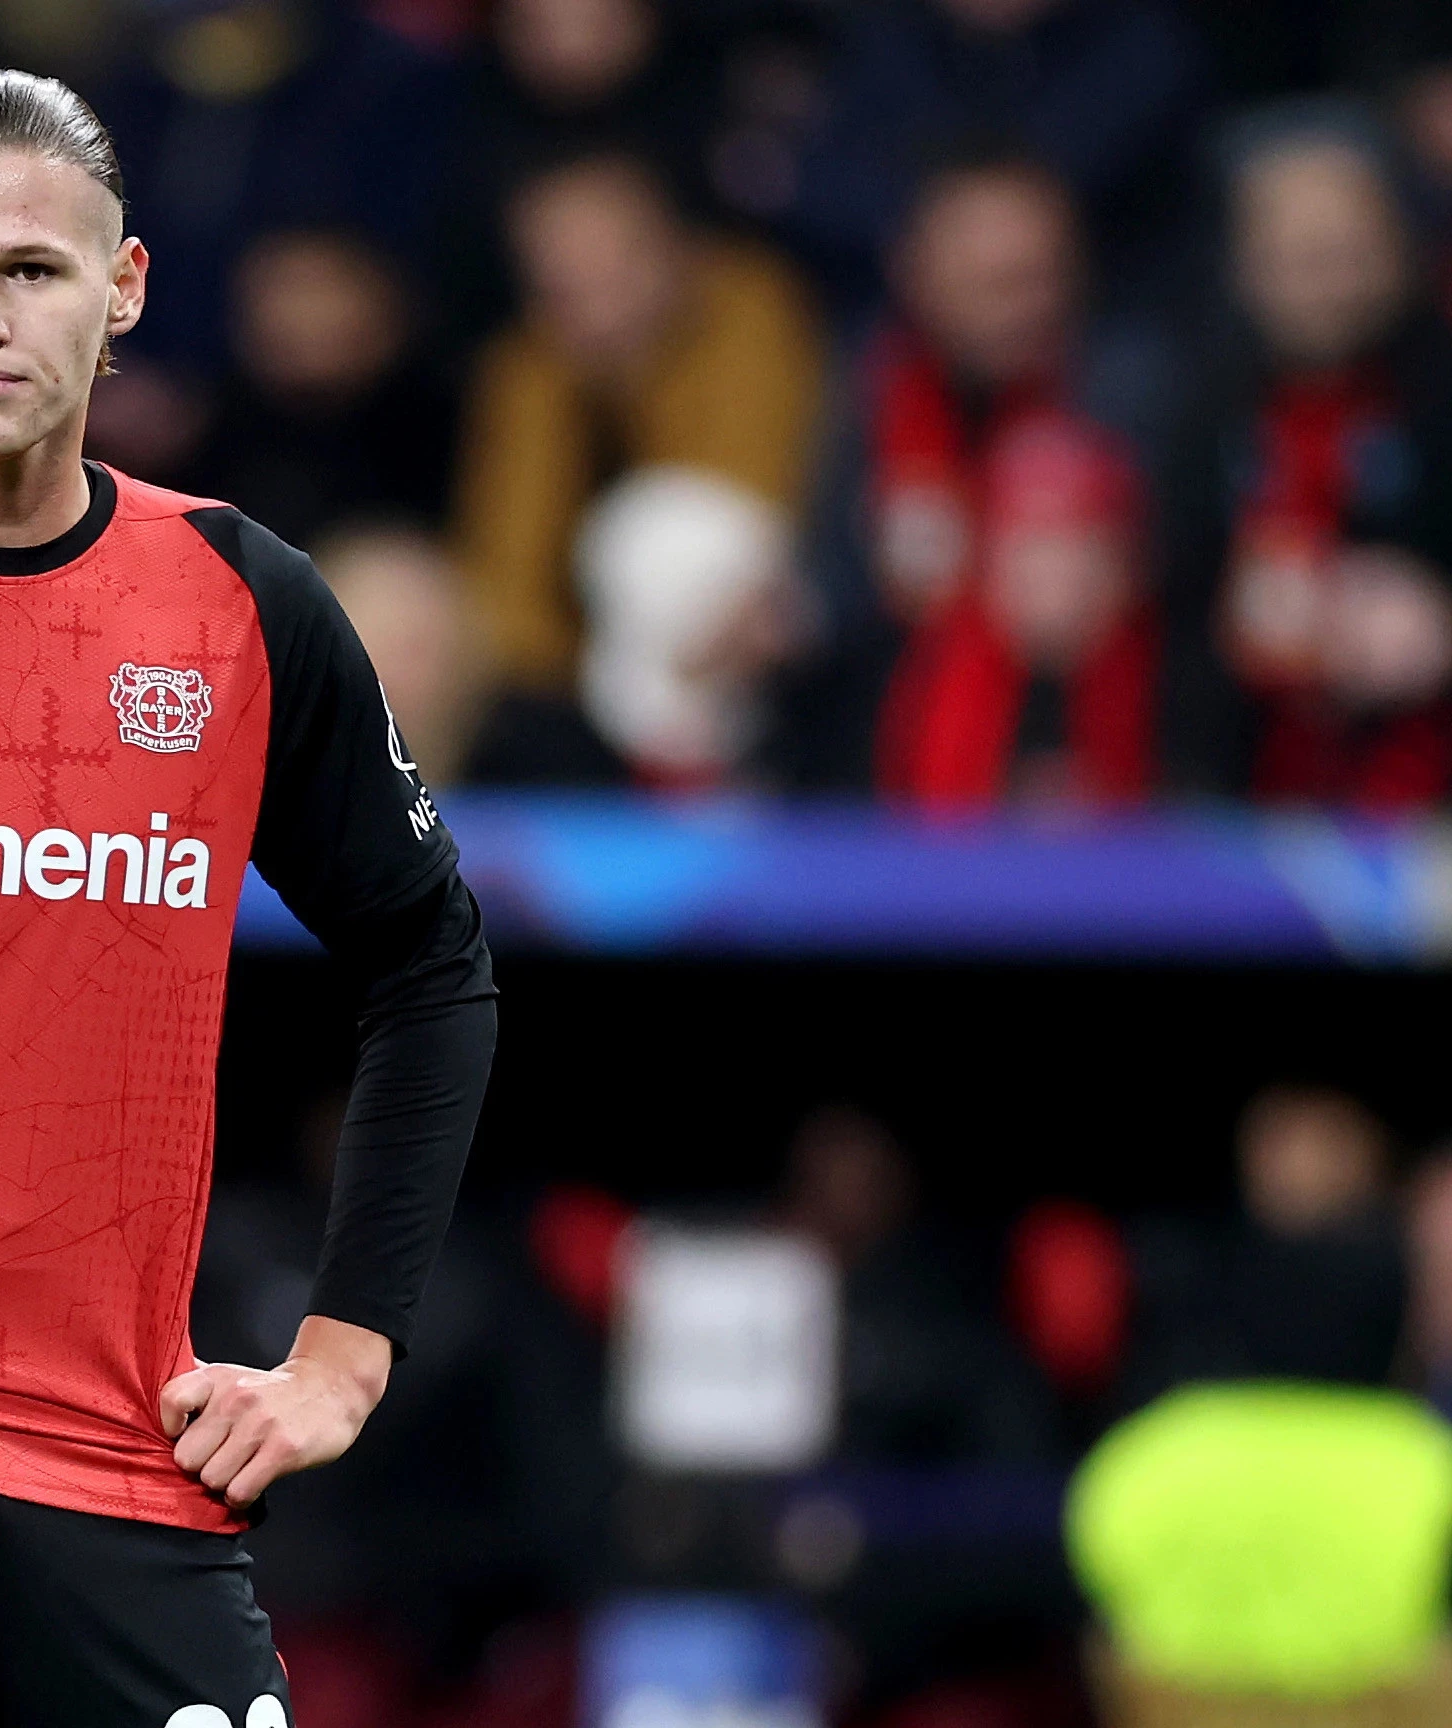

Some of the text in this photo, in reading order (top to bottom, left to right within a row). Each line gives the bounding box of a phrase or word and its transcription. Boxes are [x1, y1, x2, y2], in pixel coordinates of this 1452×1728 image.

[148, 671, 173, 682] 1904
[140, 702, 182, 717] BAYER
[156, 686, 167, 733] BAYER
[126, 729, 193, 749] Leverkusen
